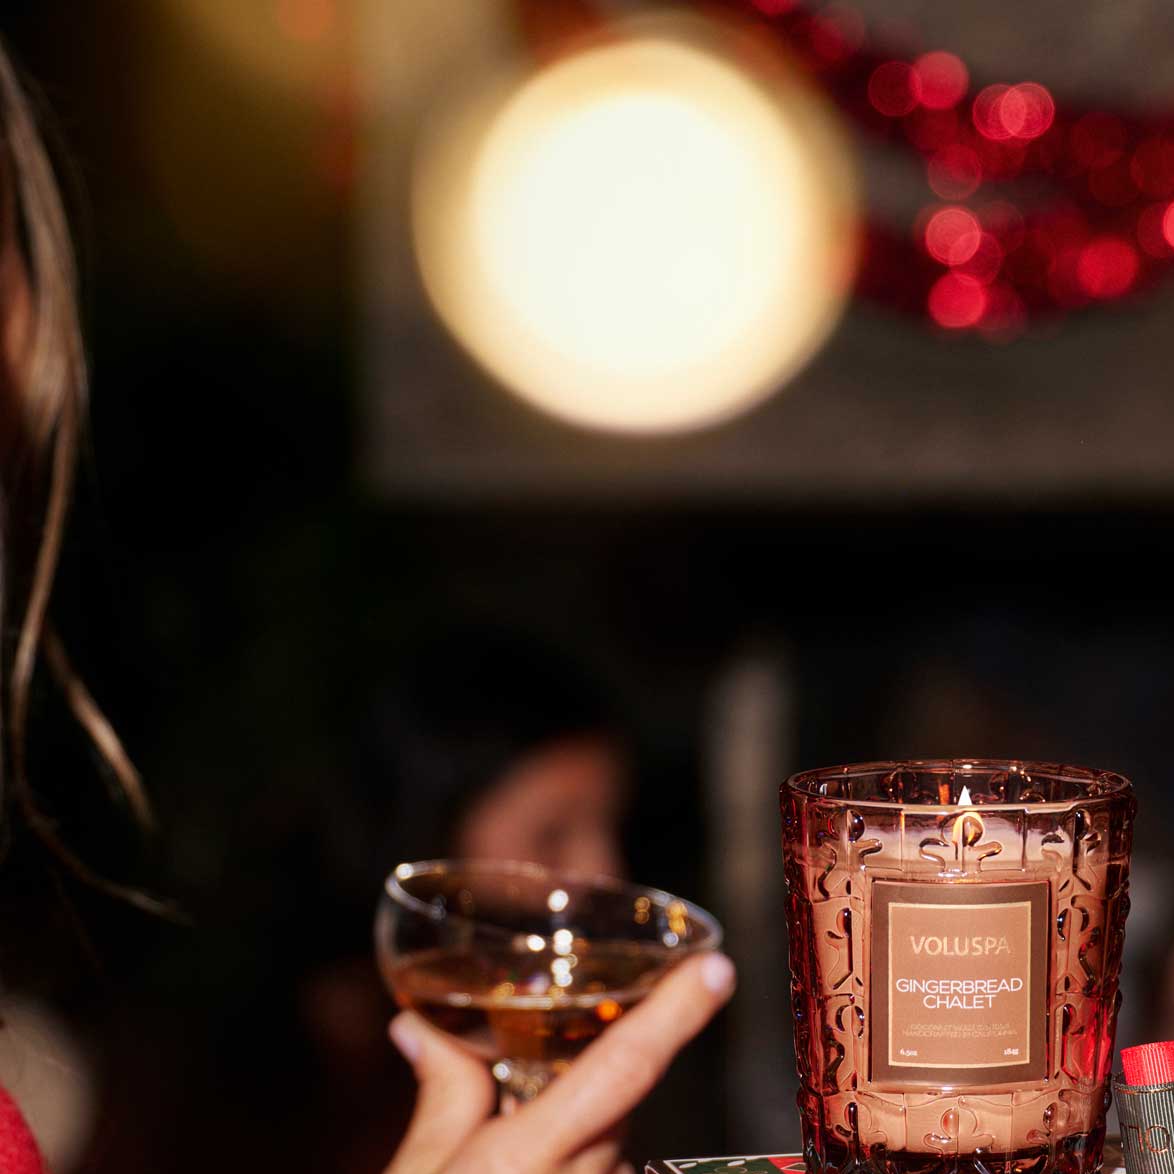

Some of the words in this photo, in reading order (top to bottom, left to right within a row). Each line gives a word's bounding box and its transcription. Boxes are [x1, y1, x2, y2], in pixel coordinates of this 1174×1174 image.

[910, 935, 1011, 956] VOLUSPA
[895, 978, 1023, 994] GINGERBREAD
[923, 994, 996, 1009] CHALET
